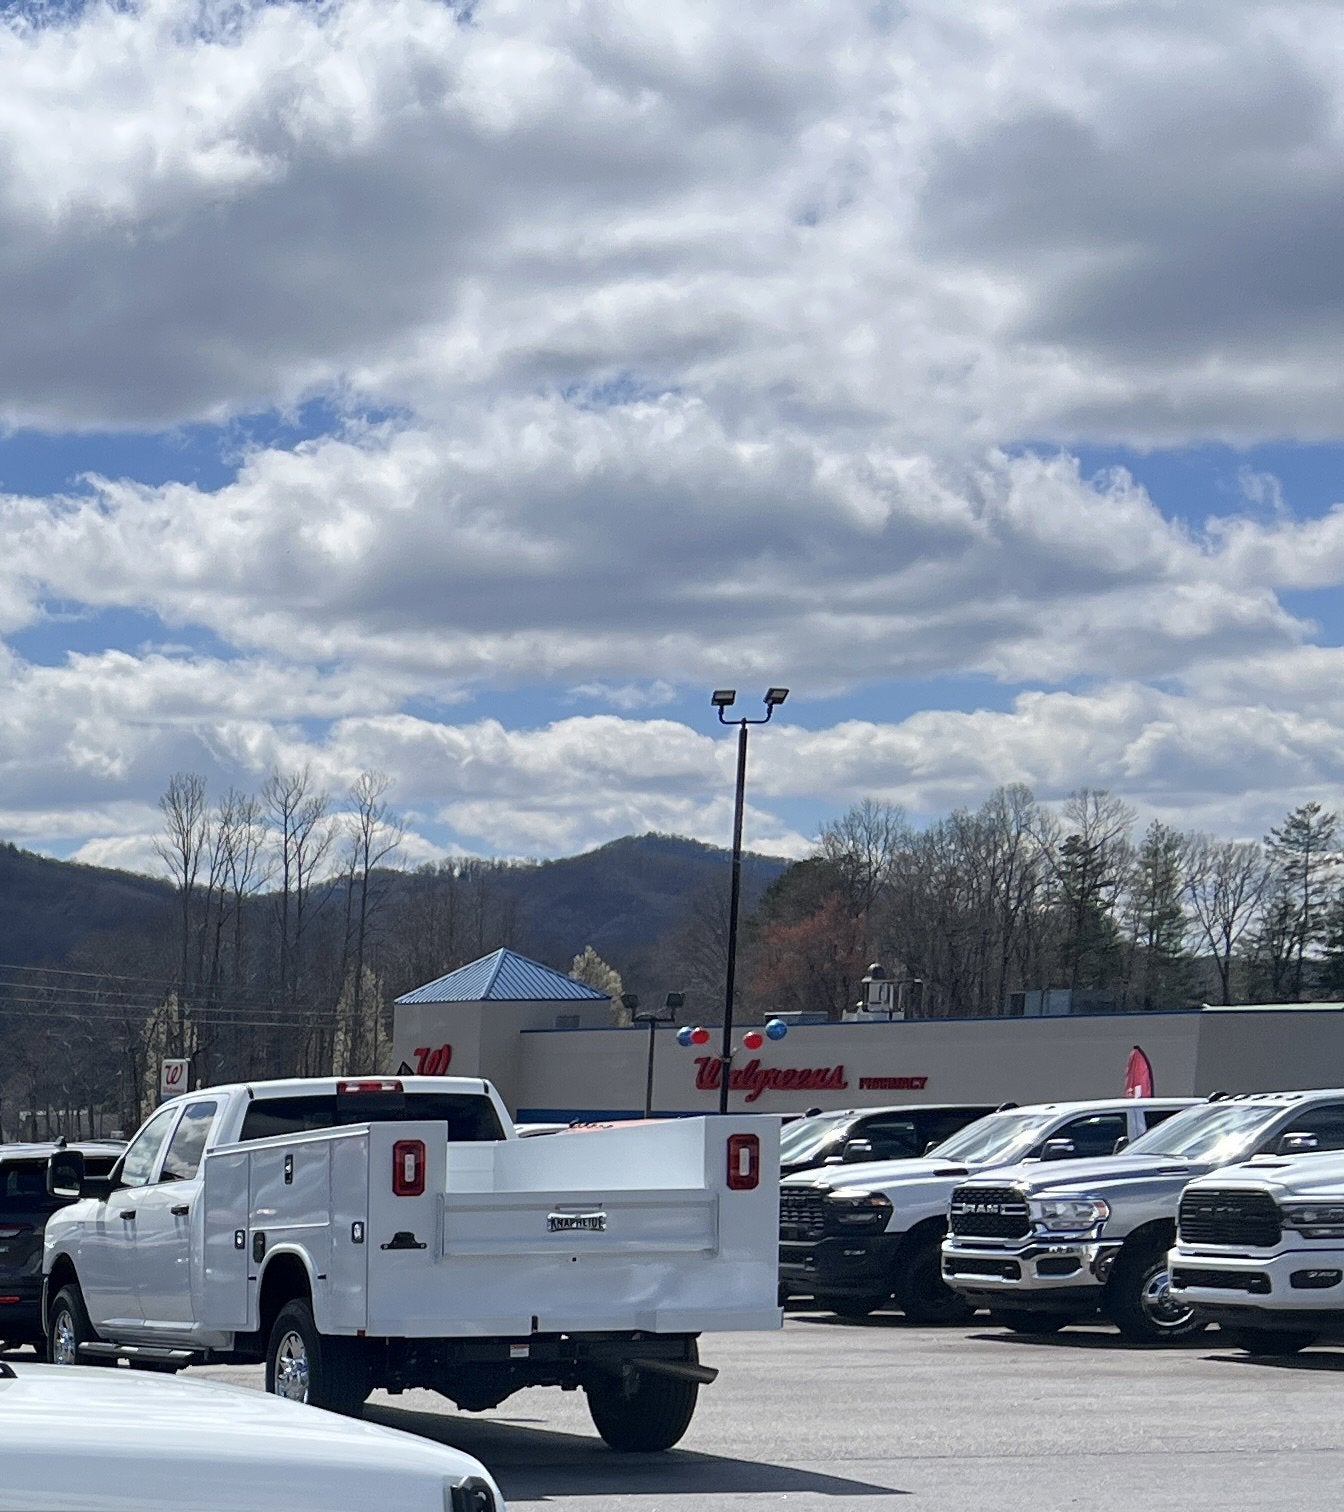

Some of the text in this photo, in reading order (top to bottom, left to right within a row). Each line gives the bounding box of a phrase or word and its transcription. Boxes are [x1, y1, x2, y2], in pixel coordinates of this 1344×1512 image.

[165, 1064, 183, 1085] W
[694, 1056, 928, 1103] Walgreens PHARMACY
[962, 1203, 999, 1214] RAM
